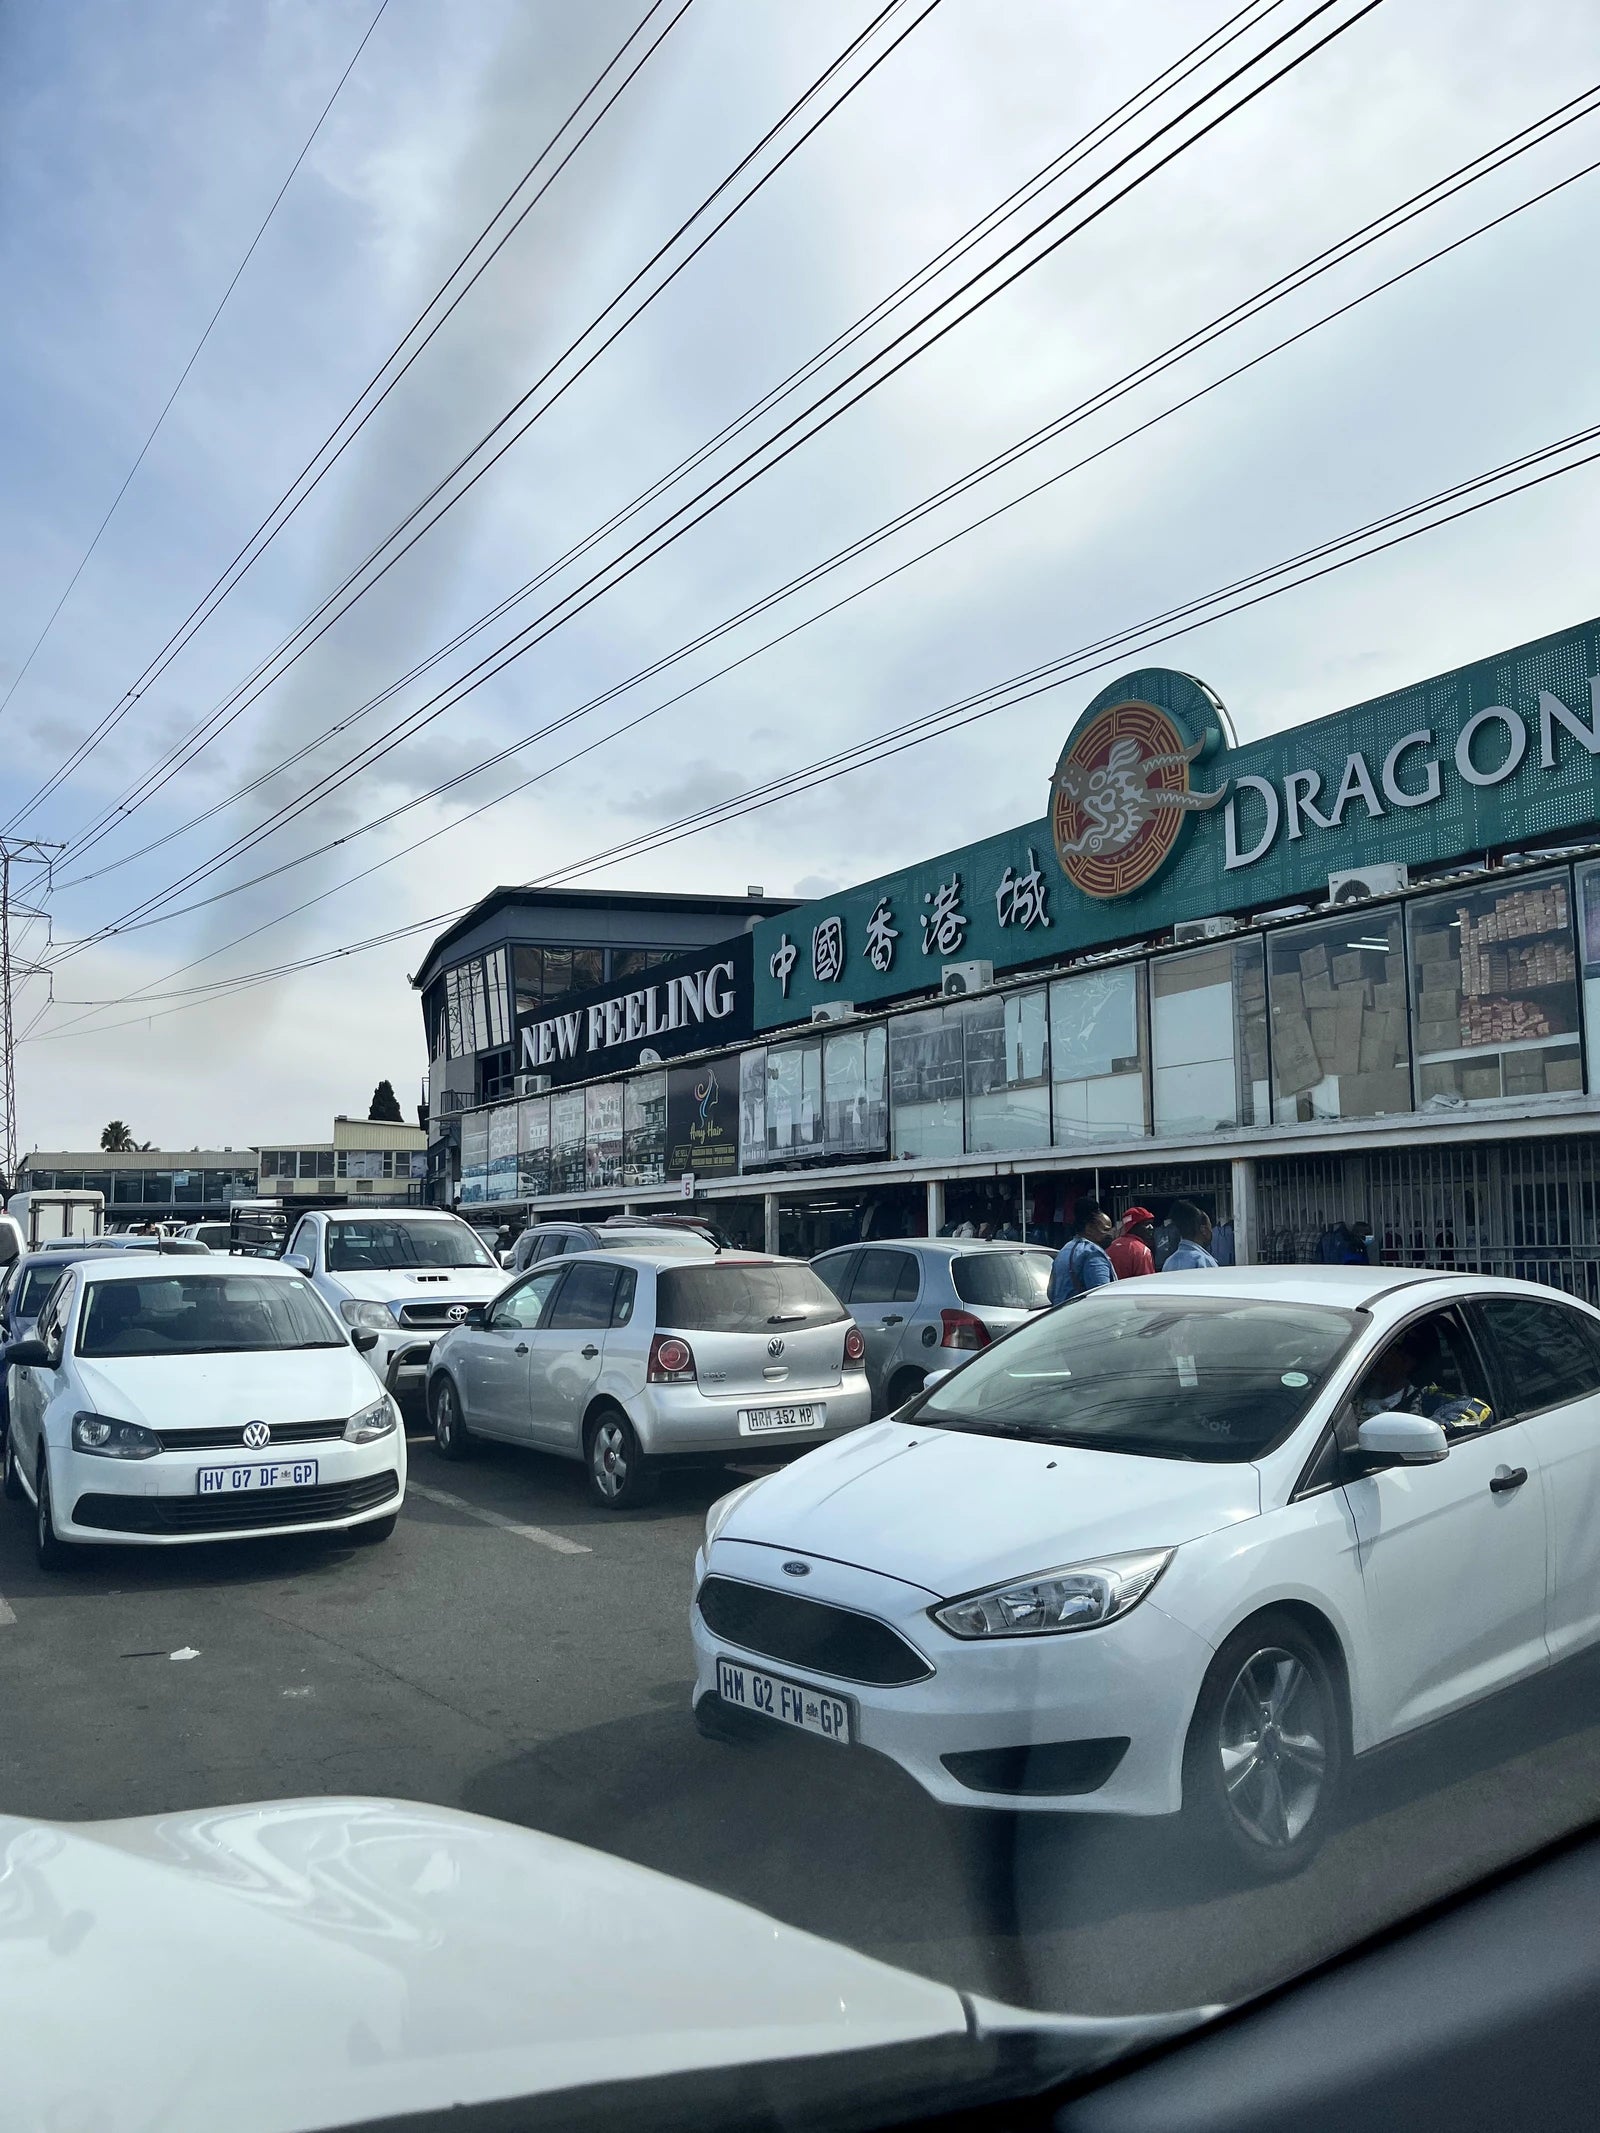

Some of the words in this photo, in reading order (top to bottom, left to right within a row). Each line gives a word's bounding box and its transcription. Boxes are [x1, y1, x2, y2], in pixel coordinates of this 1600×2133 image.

[1224, 674, 1600, 871] DRAGON
[769, 847, 1050, 999] 中國香港城
[520, 1010, 584, 1070] NEW
[586, 960, 737, 1053] FEELING
[690, 1122, 706, 1144] Amy
[707, 1120, 723, 1137] Hair
[685, 1182, 691, 1197] 5
[750, 1410, 772, 1427] HRH
[775, 1409, 796, 1425] 152
[799, 1407, 812, 1423] MP
[204, 1471, 224, 1491] HV
[232, 1469, 252, 1489] 07
[260, 1467, 279, 1486] DF
[293, 1465, 312, 1484] GP
[723, 1666, 745, 1703] HM
[752, 1676, 774, 1713] 02
[781, 1686, 804, 1724] FW
[820, 1699, 843, 1737] GP
